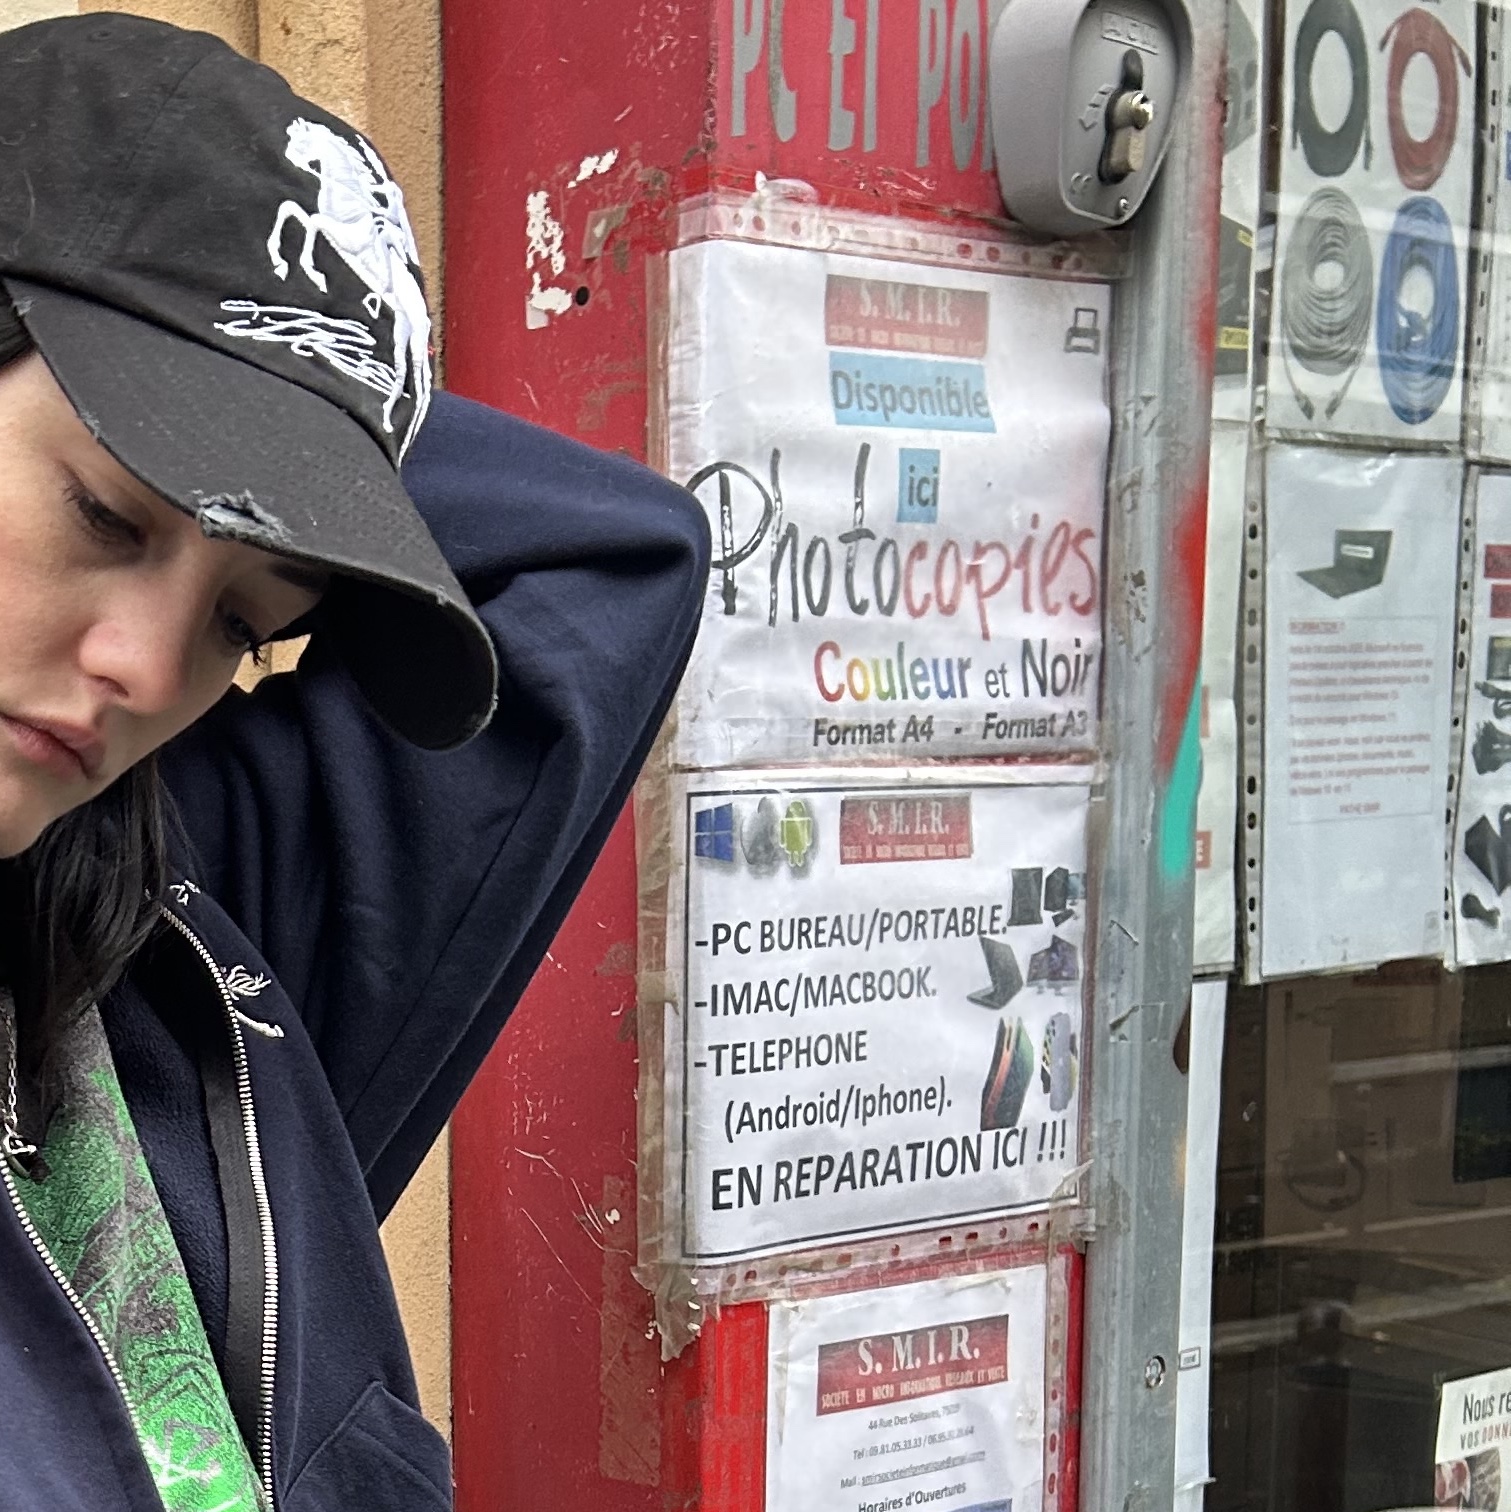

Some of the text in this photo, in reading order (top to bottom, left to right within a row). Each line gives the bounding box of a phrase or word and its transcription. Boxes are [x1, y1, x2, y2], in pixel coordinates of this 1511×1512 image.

[831, 369, 992, 422] Disponible
[908, 464, 938, 507] ici
[686, 442, 1097, 641] Photocopies
[814, 637, 1093, 702] Couleur et Noir
[813, 716, 896, 746] Format
[901, 714, 934, 742] A4
[982, 711, 1056, 739] Format
[1060, 709, 1088, 737] A3
[760, 904, 1007, 953] BUREAU/PORTABLE.
[725, 1076, 952, 1143] (Android/Iphone).
[712, 1166, 762, 1210] EN
[773, 1131, 982, 1203] REPARATION
[992, 1126, 1027, 1170] ICI
[1463, 1392, 1495, 1424] Nous
[906, 1482, 966, 1506] d'Ouvertures
